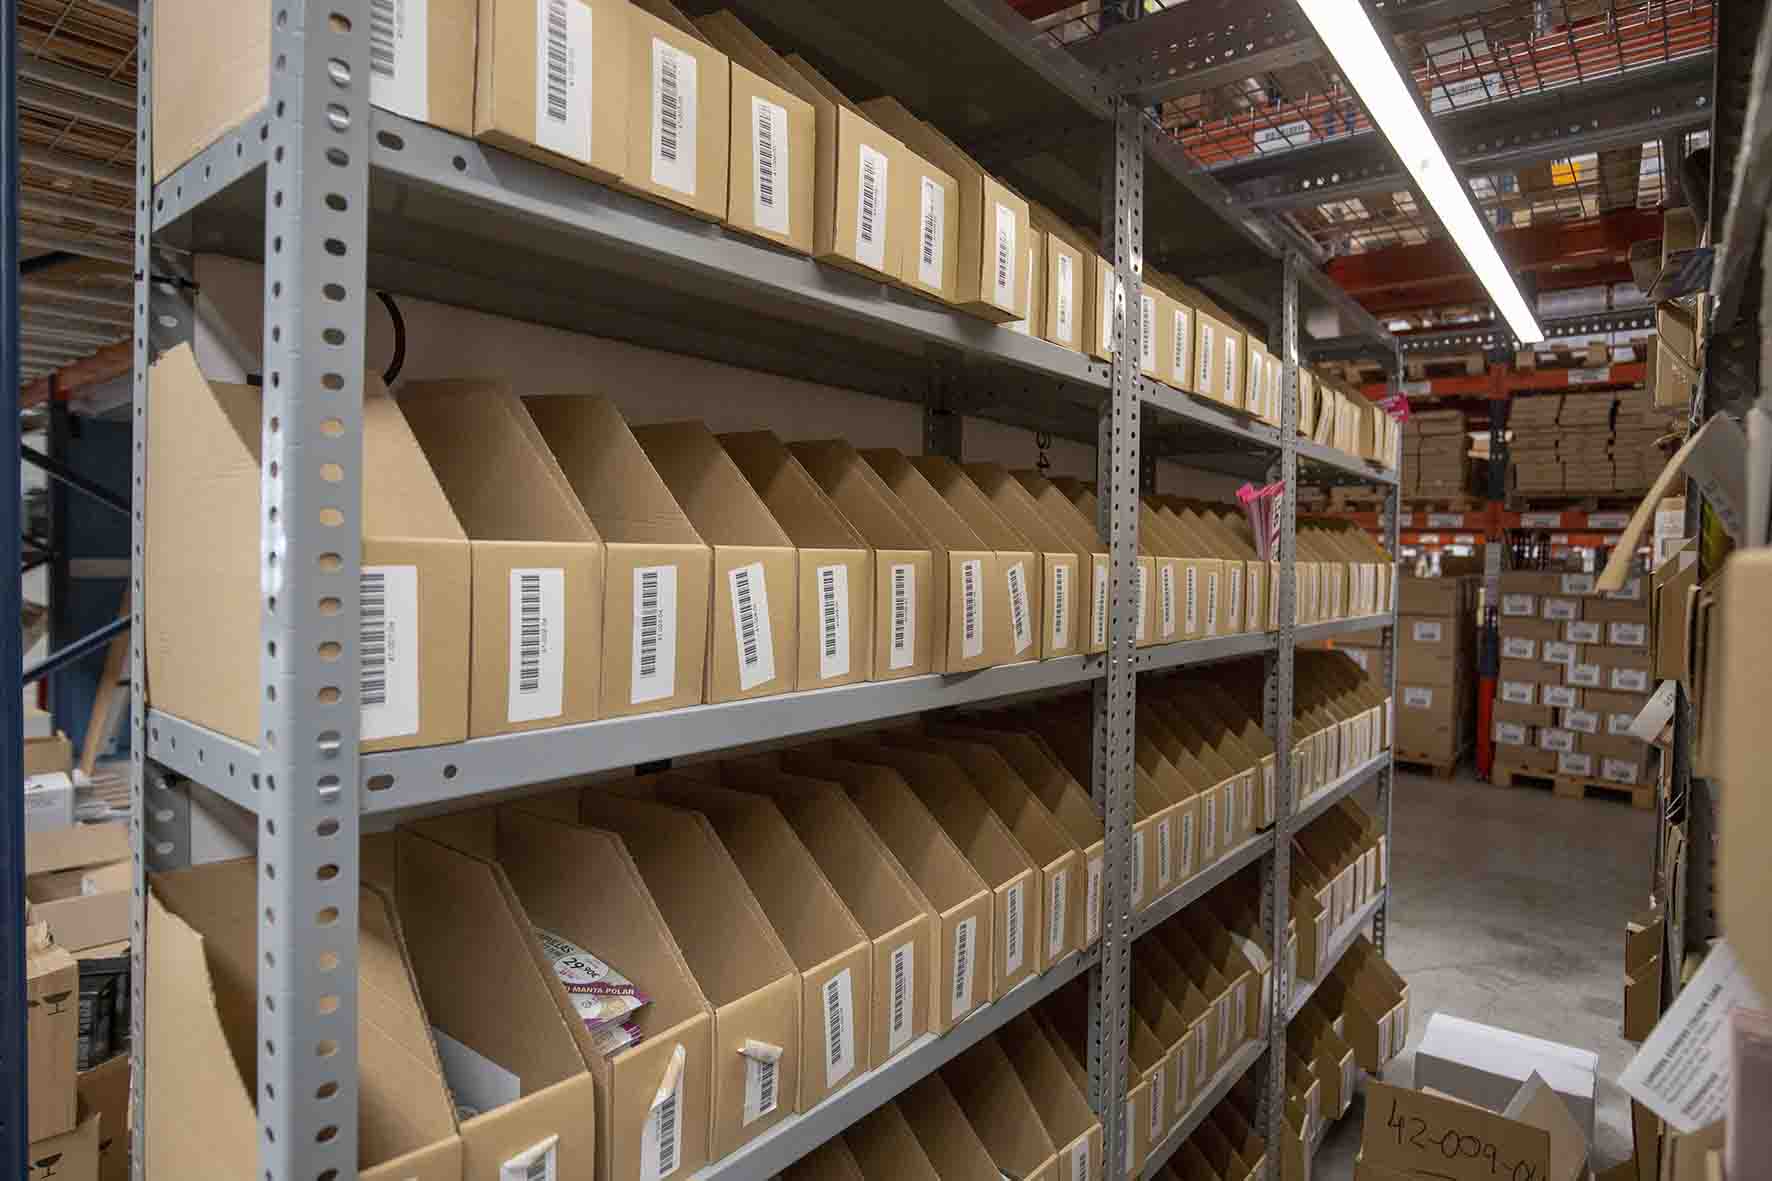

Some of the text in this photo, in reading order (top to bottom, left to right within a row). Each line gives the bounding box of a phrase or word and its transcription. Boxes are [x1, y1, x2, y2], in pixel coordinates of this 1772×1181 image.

[563, 957, 584, 968] 29
[572, 986, 603, 994] MANTA
[605, 986, 634, 995] POLAR
